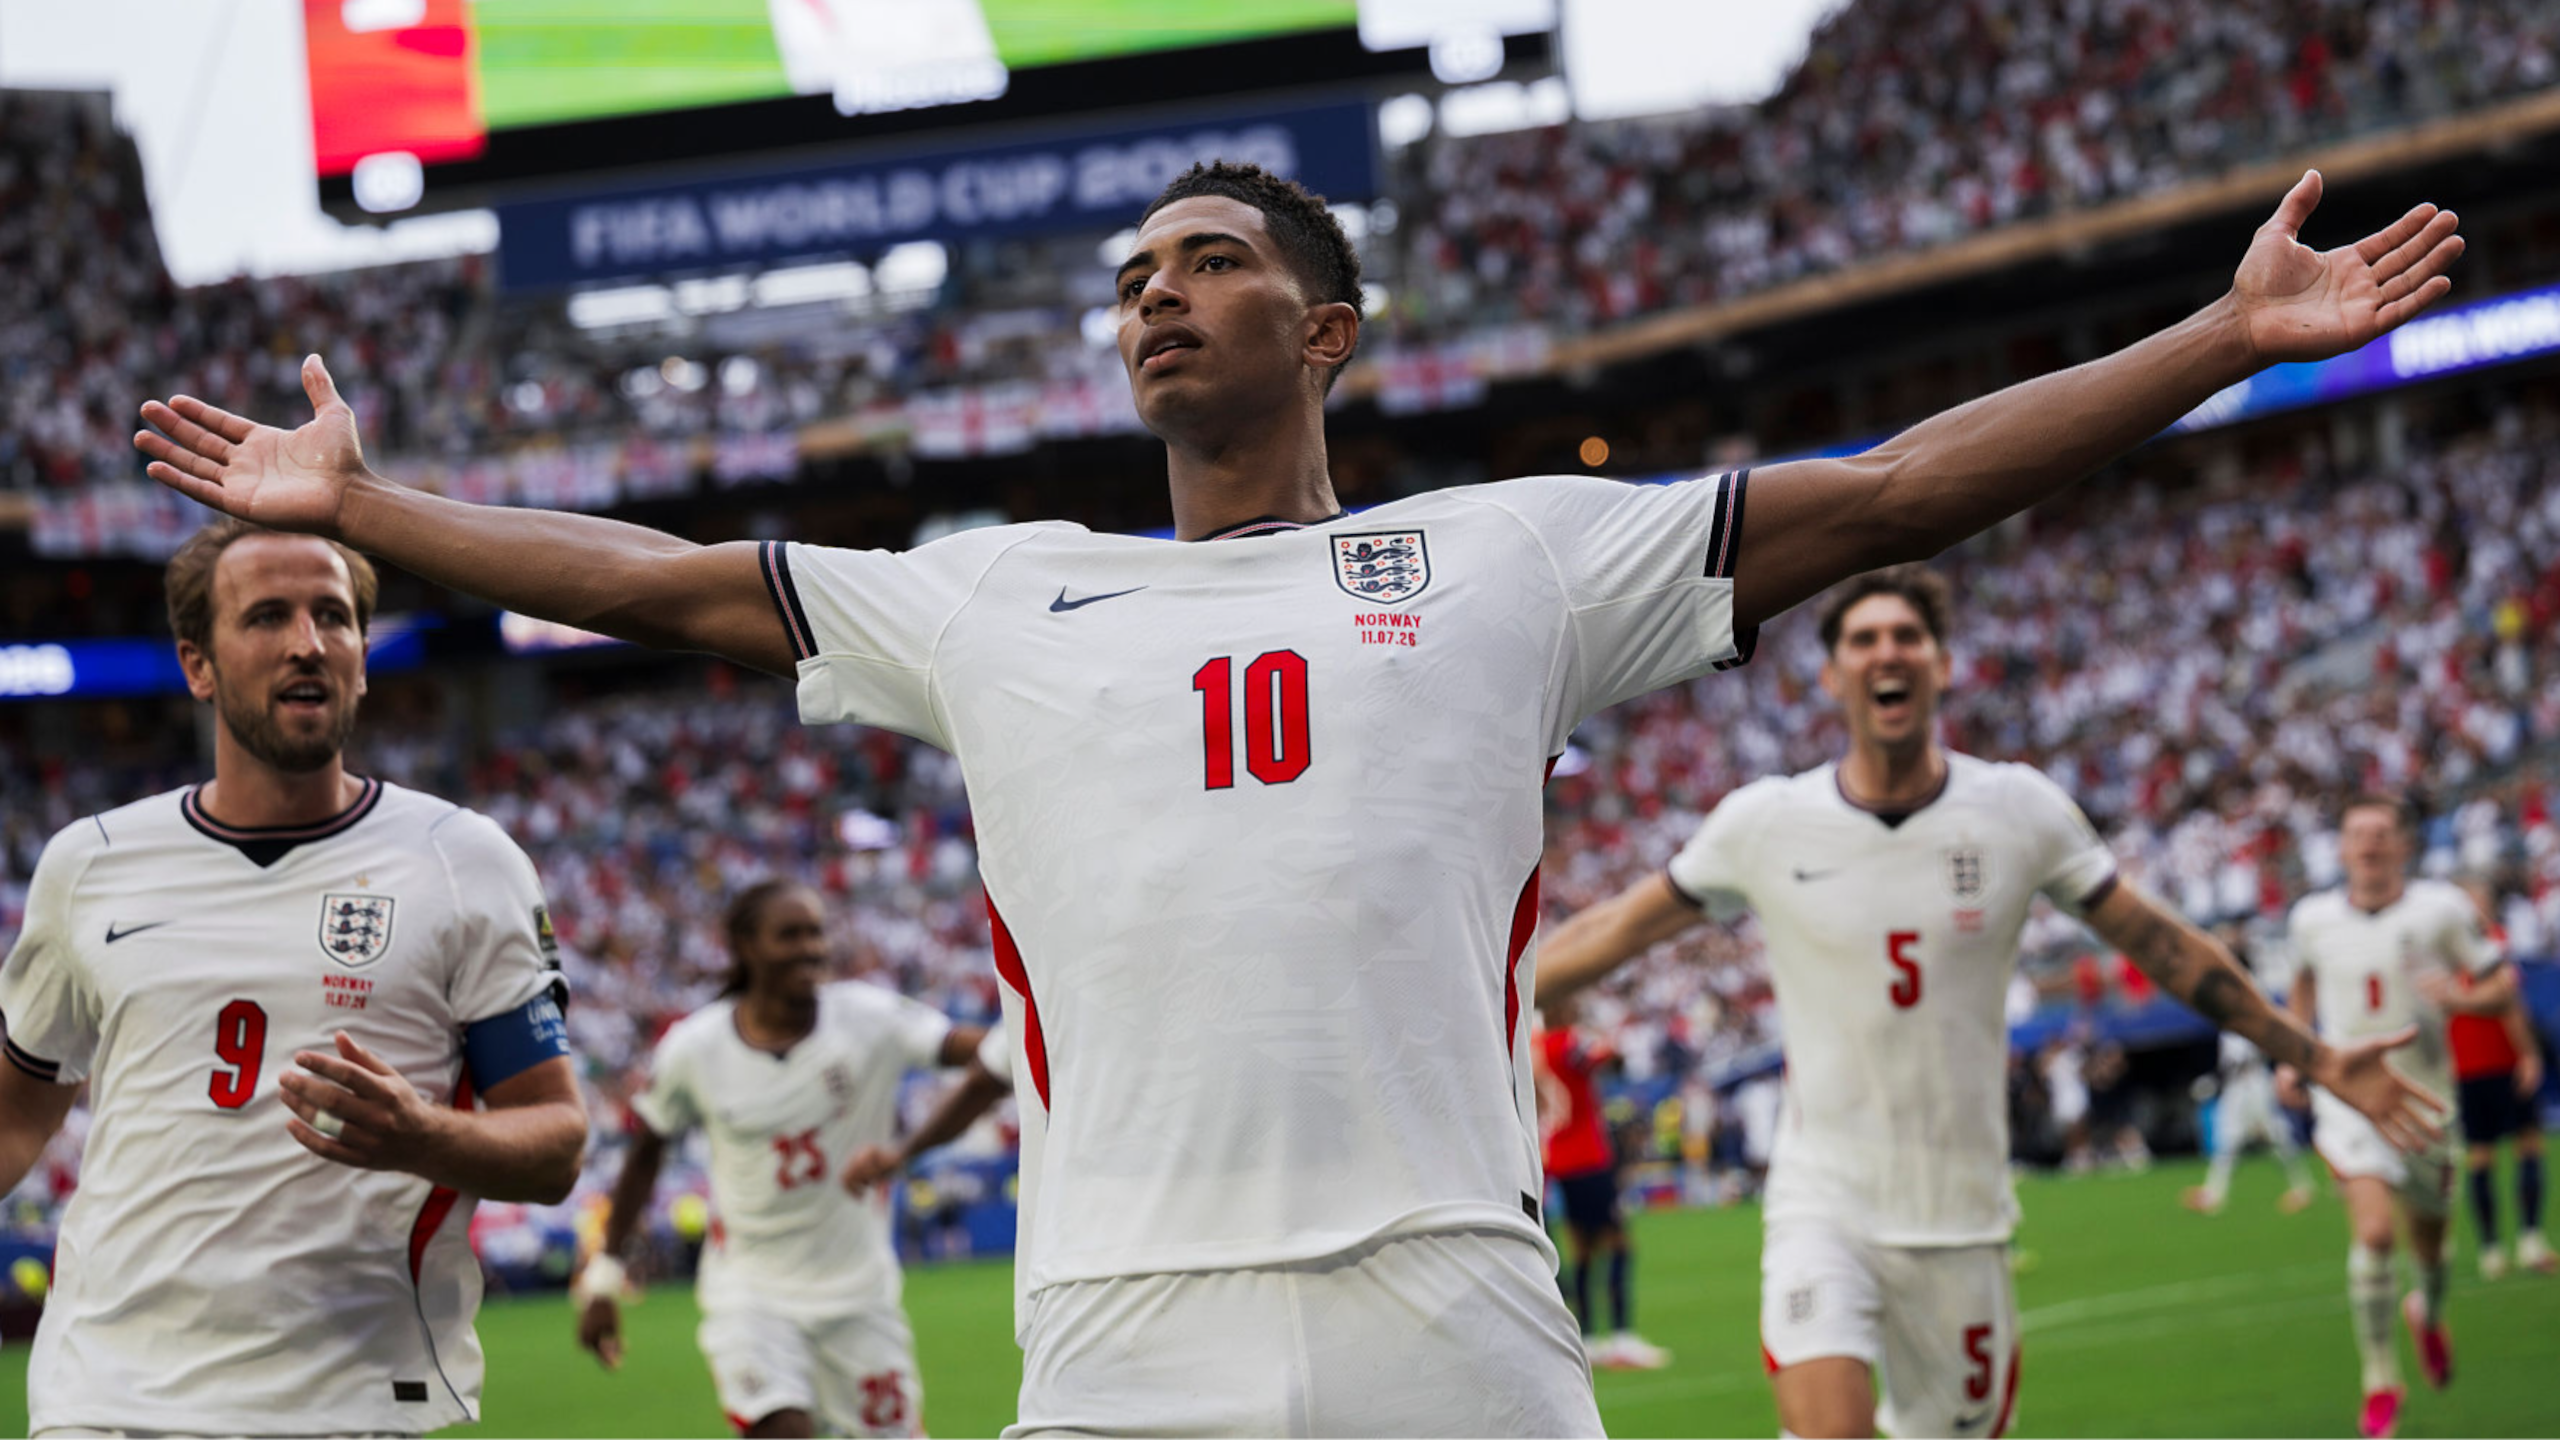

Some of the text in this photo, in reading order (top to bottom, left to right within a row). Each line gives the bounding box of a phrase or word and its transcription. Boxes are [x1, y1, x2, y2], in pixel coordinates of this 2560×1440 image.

[572, 200, 706, 268] FIFA
[708, 168, 936, 248] WORLD
[942, 152, 1065, 227] CUP
[2471, 292, 2560, 362] WOR
[1355, 613, 1422, 629] NORWAY
[1361, 630, 1416, 647] 11.07.26
[1193, 648, 1311, 791] 10
[322, 974, 375, 994] NORWAY
[1886, 929, 1922, 1010] 5
[207, 998, 268, 1110] 9
[770, 1126, 827, 1192] 25
[1963, 1323, 1993, 1402] 5
